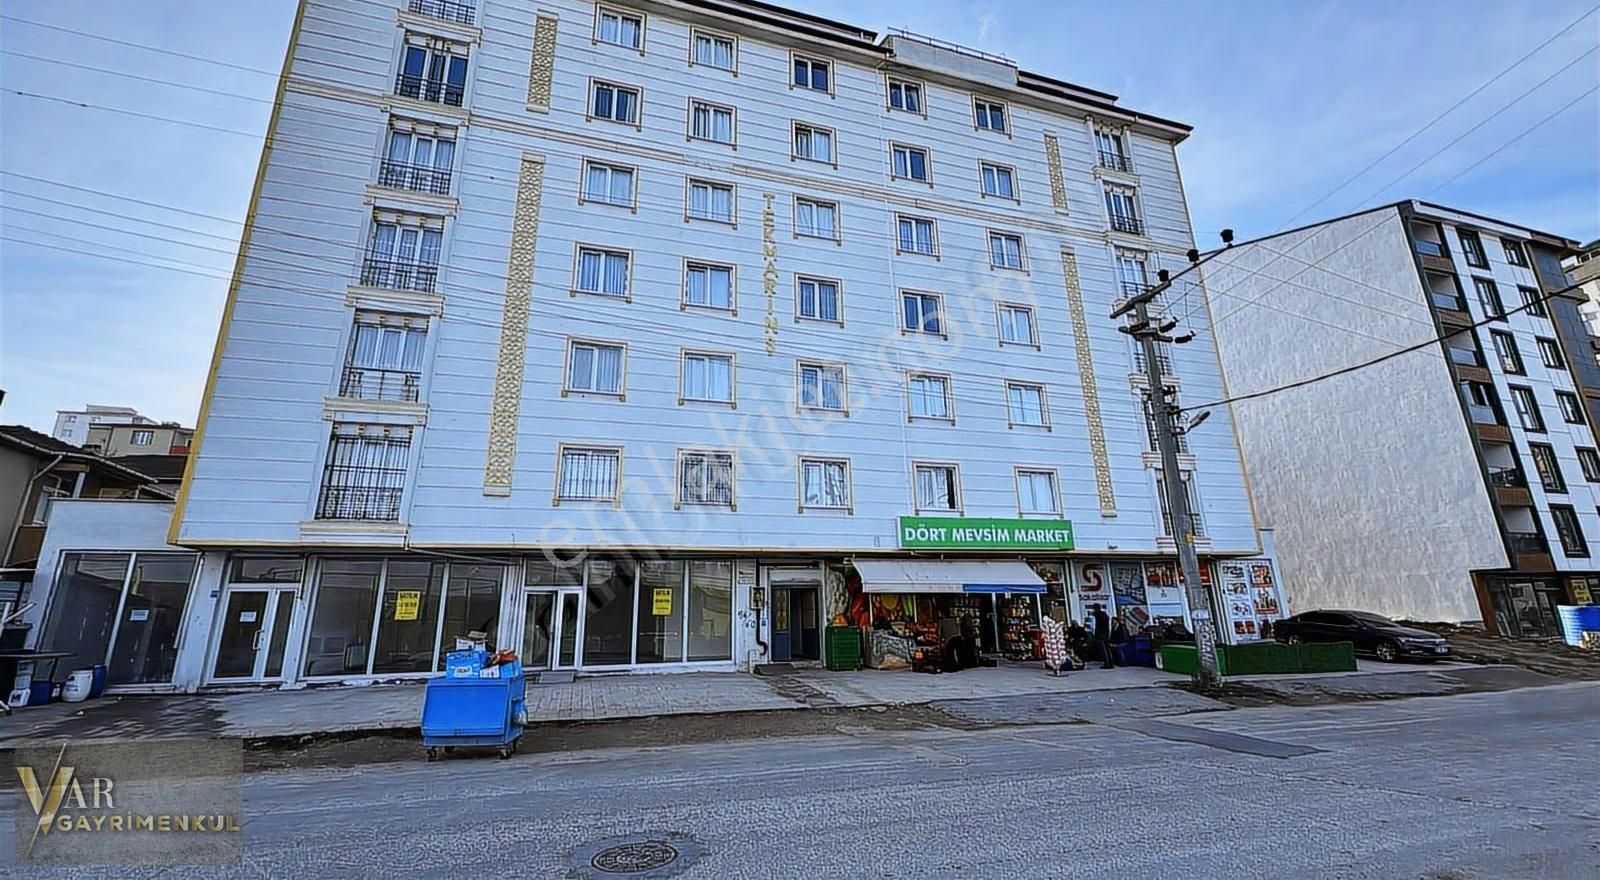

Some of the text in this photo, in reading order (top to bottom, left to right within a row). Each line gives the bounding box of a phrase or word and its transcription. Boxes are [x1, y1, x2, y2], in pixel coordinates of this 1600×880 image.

[905, 524, 1070, 543] DÖRT MEVSİM MARKET
